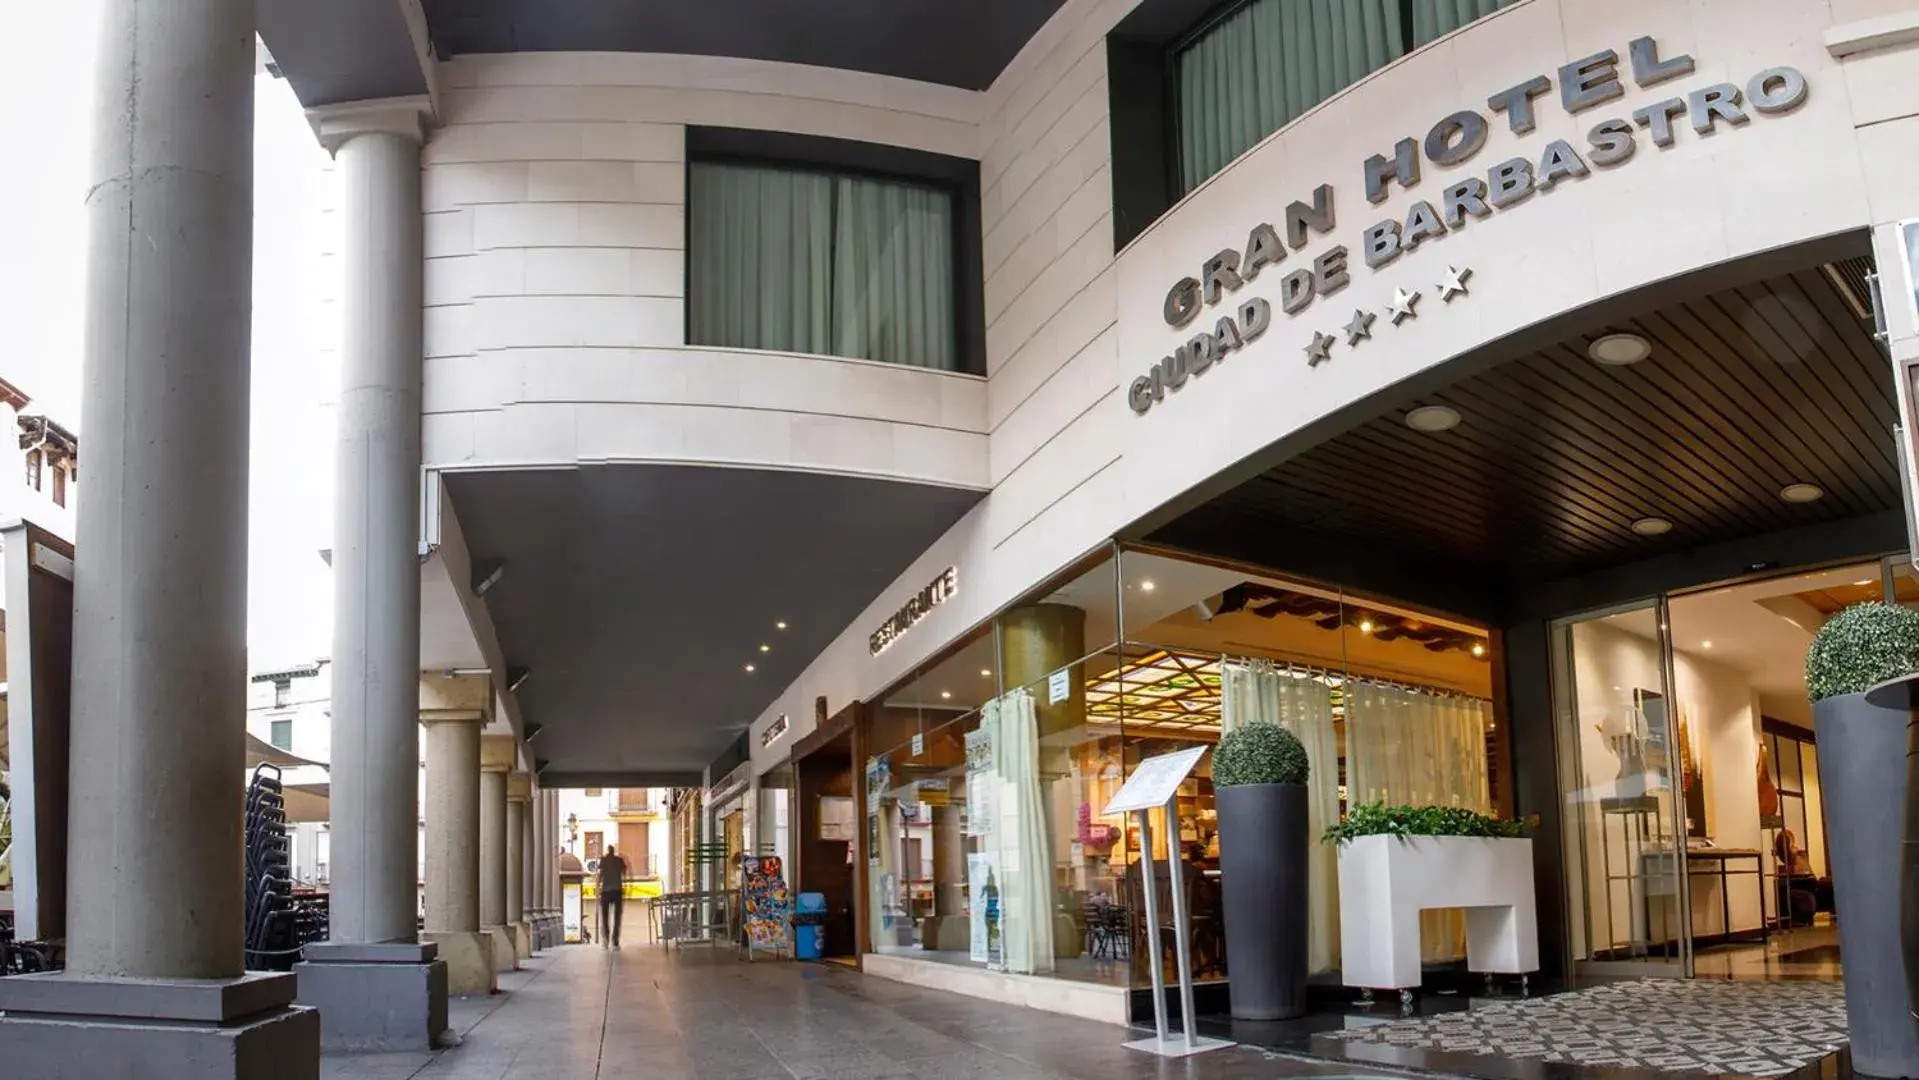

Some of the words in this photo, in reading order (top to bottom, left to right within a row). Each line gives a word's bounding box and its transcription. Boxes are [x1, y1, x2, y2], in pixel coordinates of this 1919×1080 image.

[1128, 297, 1272, 413] CIUDAD
[1281, 245, 1351, 316] DE
[1363, 66, 1810, 270] BARBASTRO
[1164, 184, 1336, 327] GRAN
[1364, 35, 1696, 205] HOTEL
[869, 566, 957, 656] RESTAURANTE
